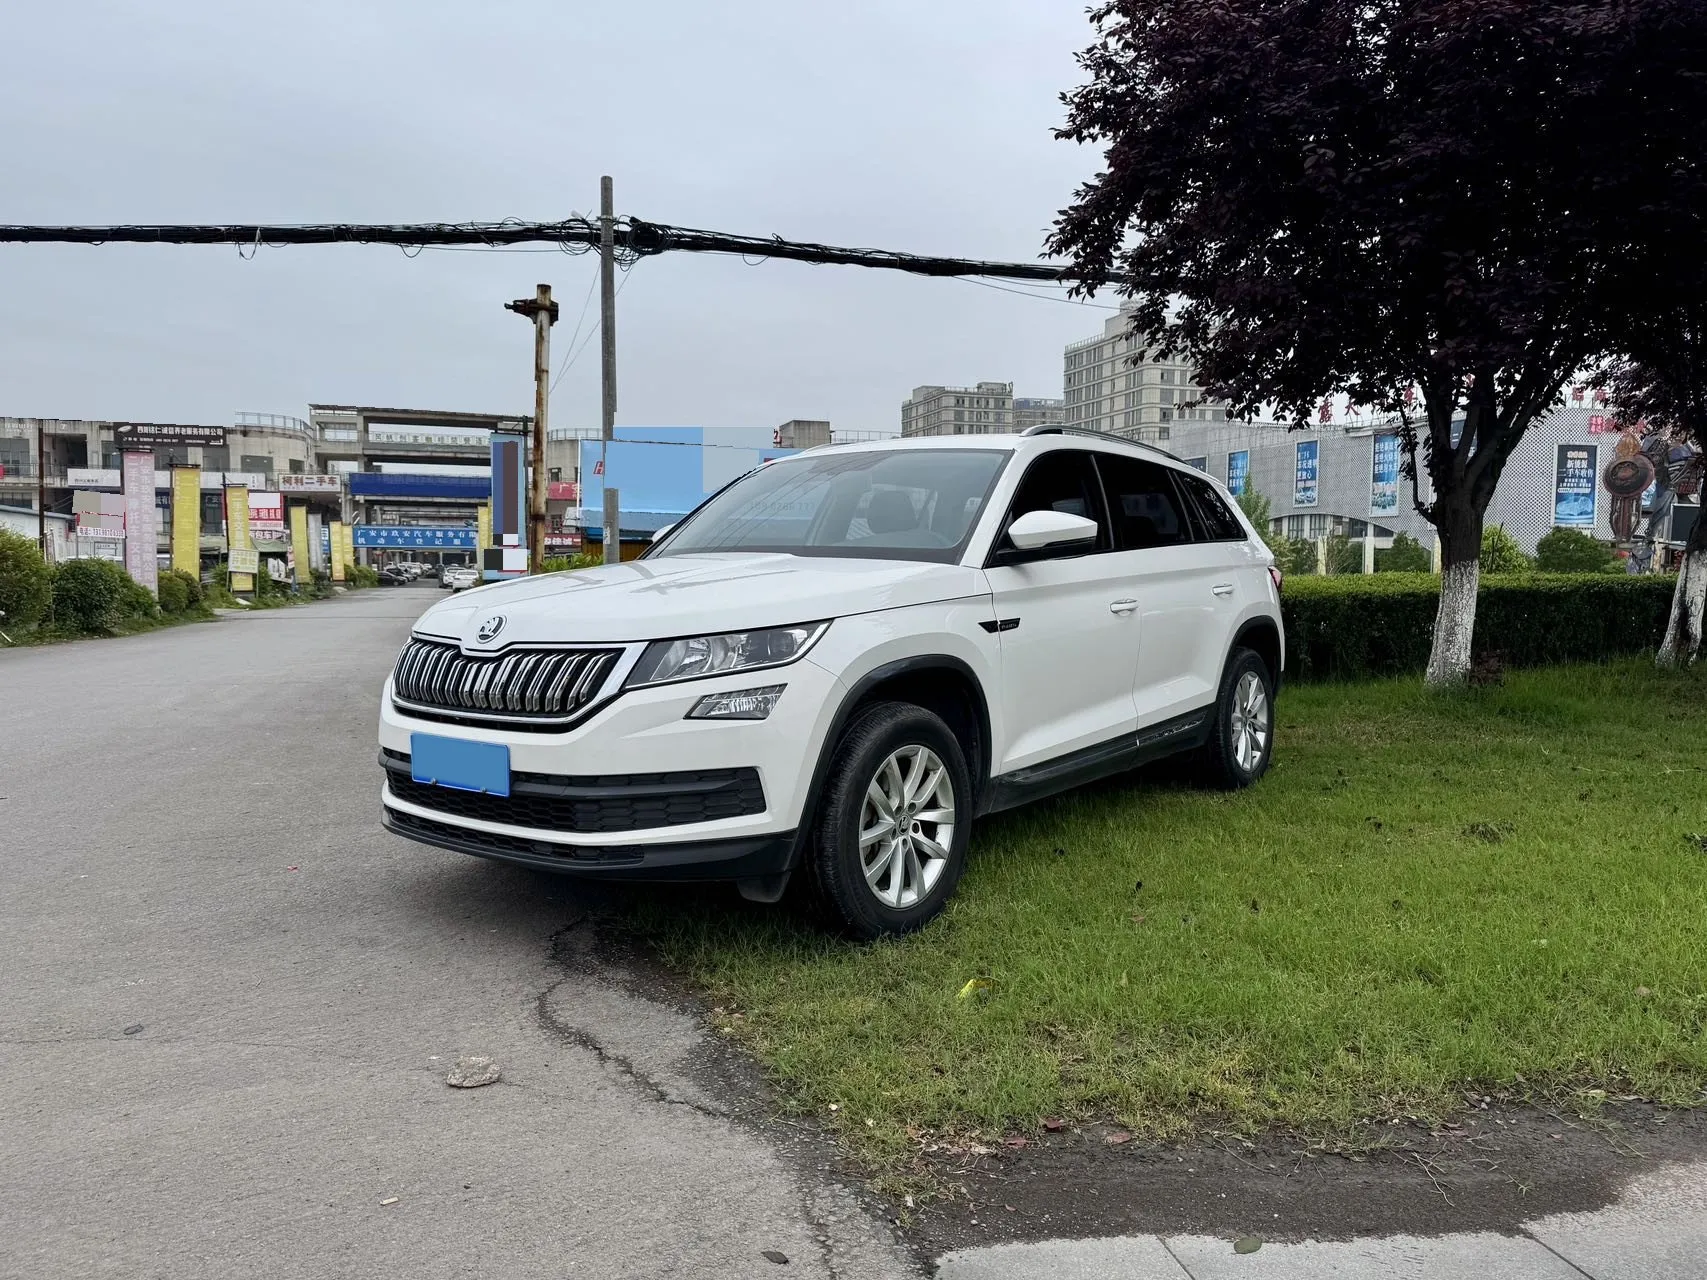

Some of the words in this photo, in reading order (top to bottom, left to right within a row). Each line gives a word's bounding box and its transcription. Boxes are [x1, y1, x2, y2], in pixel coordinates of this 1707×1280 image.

[282, 476, 337, 486] 柯利二手车
